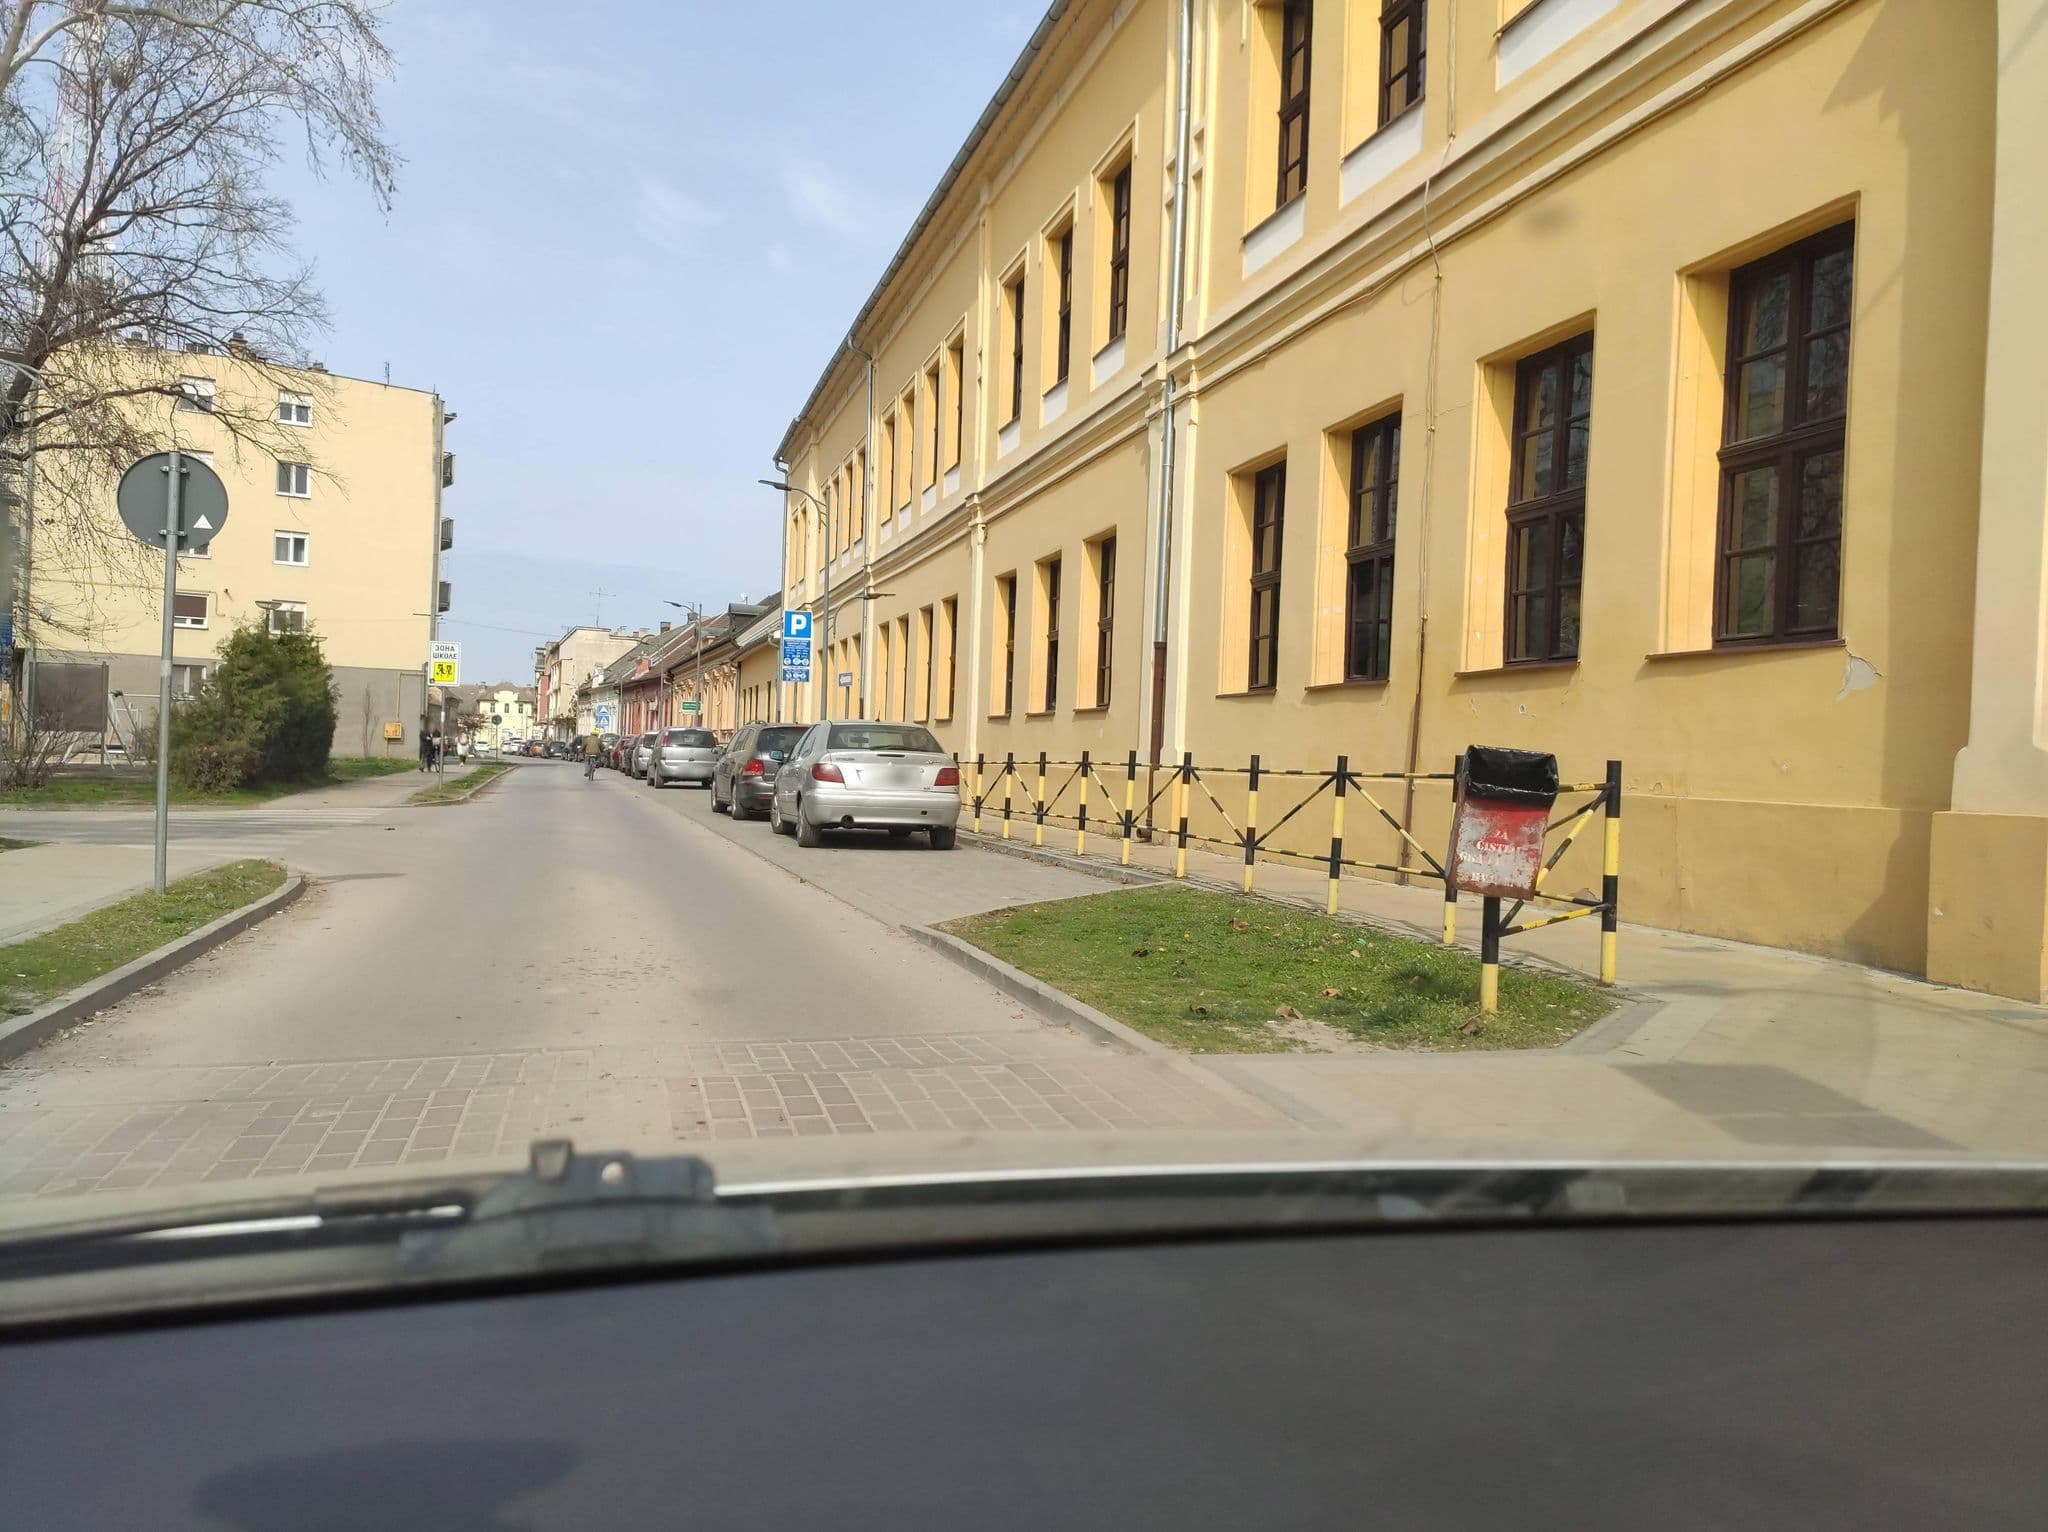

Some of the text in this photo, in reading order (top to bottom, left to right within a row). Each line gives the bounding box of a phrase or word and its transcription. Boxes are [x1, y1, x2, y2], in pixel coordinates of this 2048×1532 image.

[791, 614, 807, 635] P
[435, 644, 455, 652] ЗОНА
[432, 652, 457, 660] ШКОЛЕ
